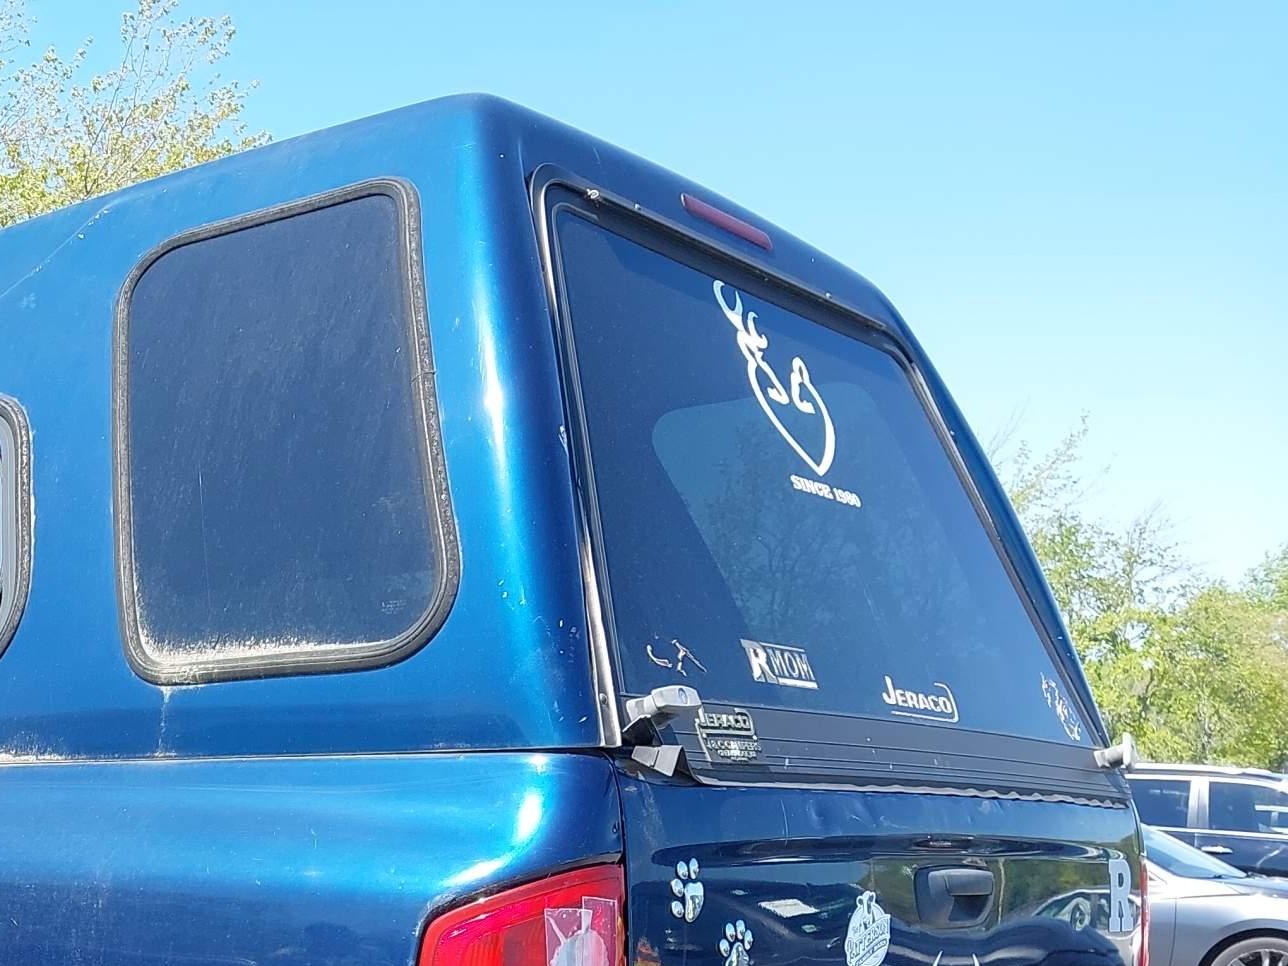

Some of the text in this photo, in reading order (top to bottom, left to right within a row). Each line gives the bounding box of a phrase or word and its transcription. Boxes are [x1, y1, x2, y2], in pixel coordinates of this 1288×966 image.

[790, 474, 834, 500] SINCE
[882, 675, 953, 714] JERACO
[695, 707, 752, 729] JERACO
[1109, 858, 1134, 933] R
